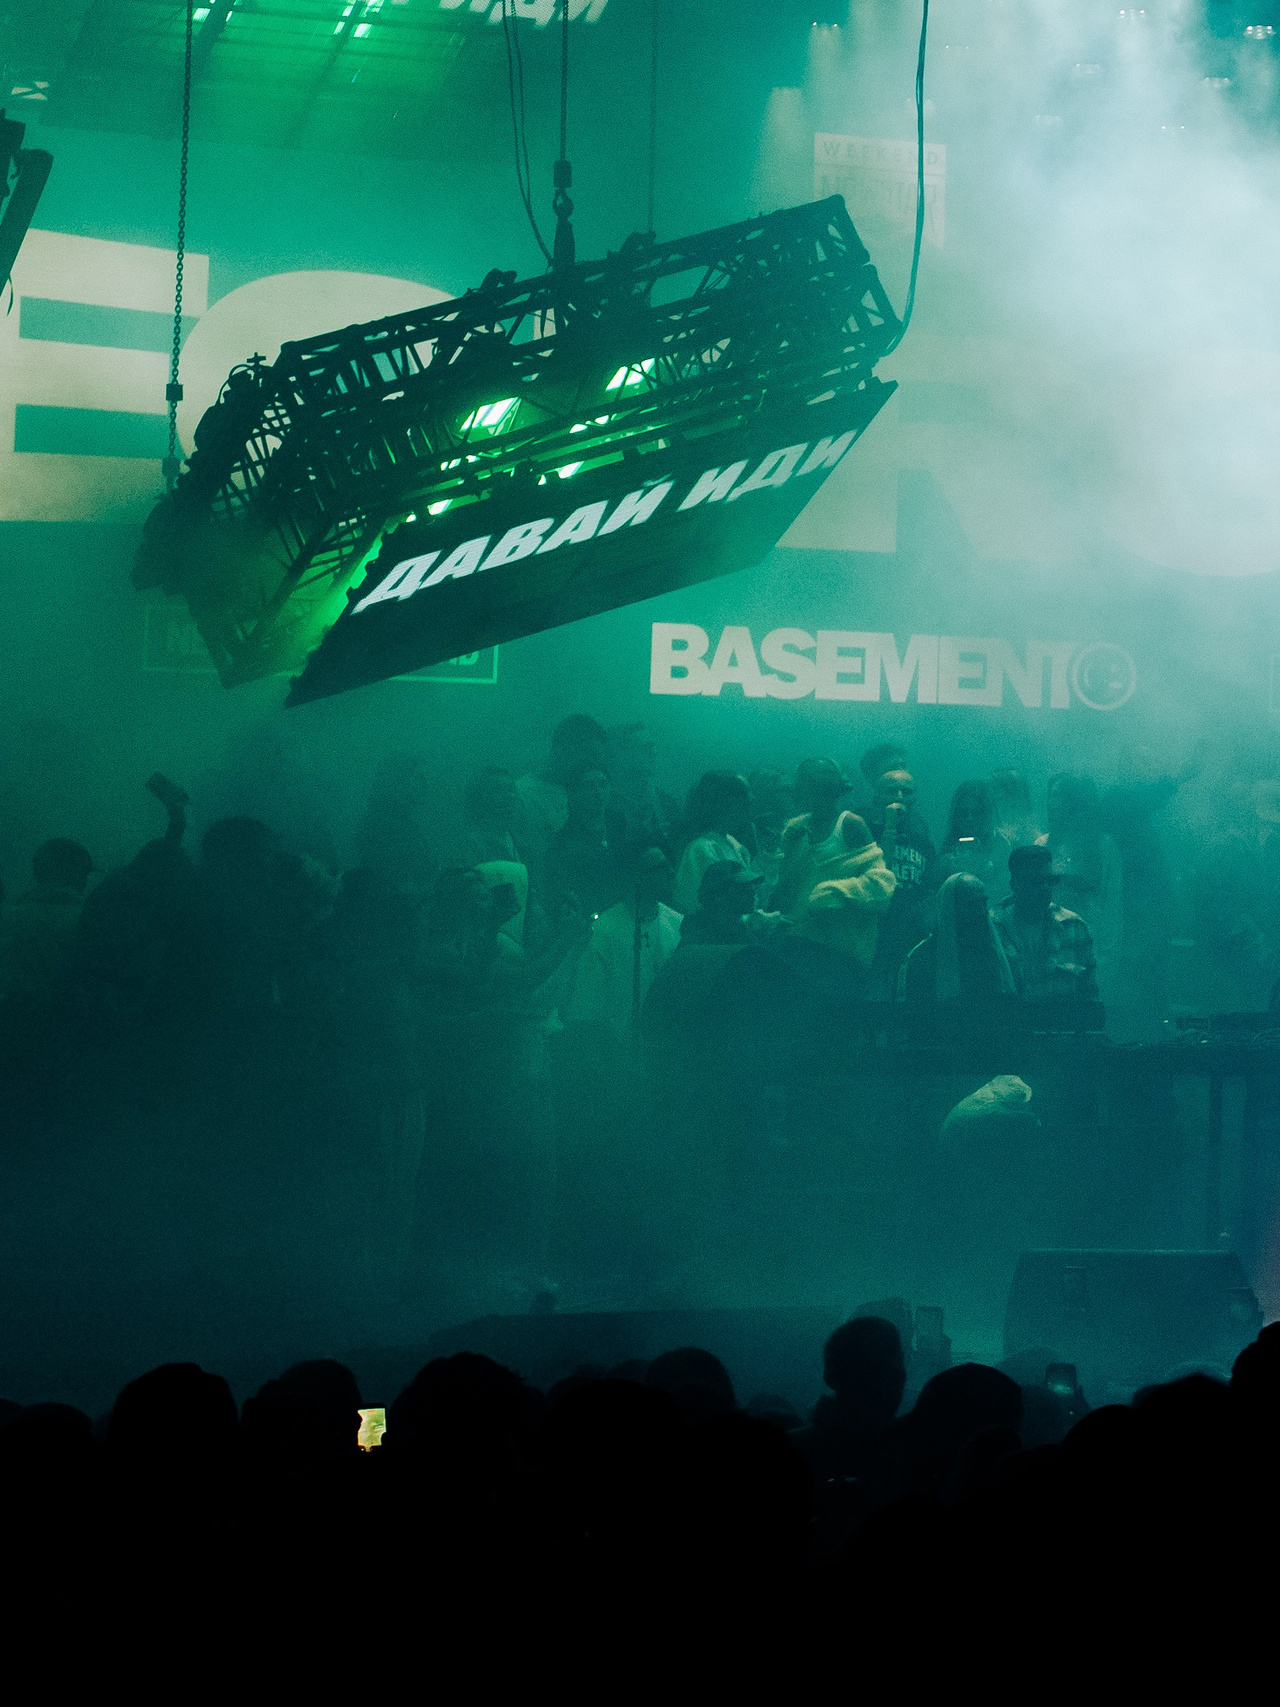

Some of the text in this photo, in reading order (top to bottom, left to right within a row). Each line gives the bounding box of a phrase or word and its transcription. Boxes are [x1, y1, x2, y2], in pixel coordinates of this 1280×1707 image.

[350, 429, 859, 616] ДАВАЙ ИДИ
[650, 621, 1072, 709] BASEMENT
